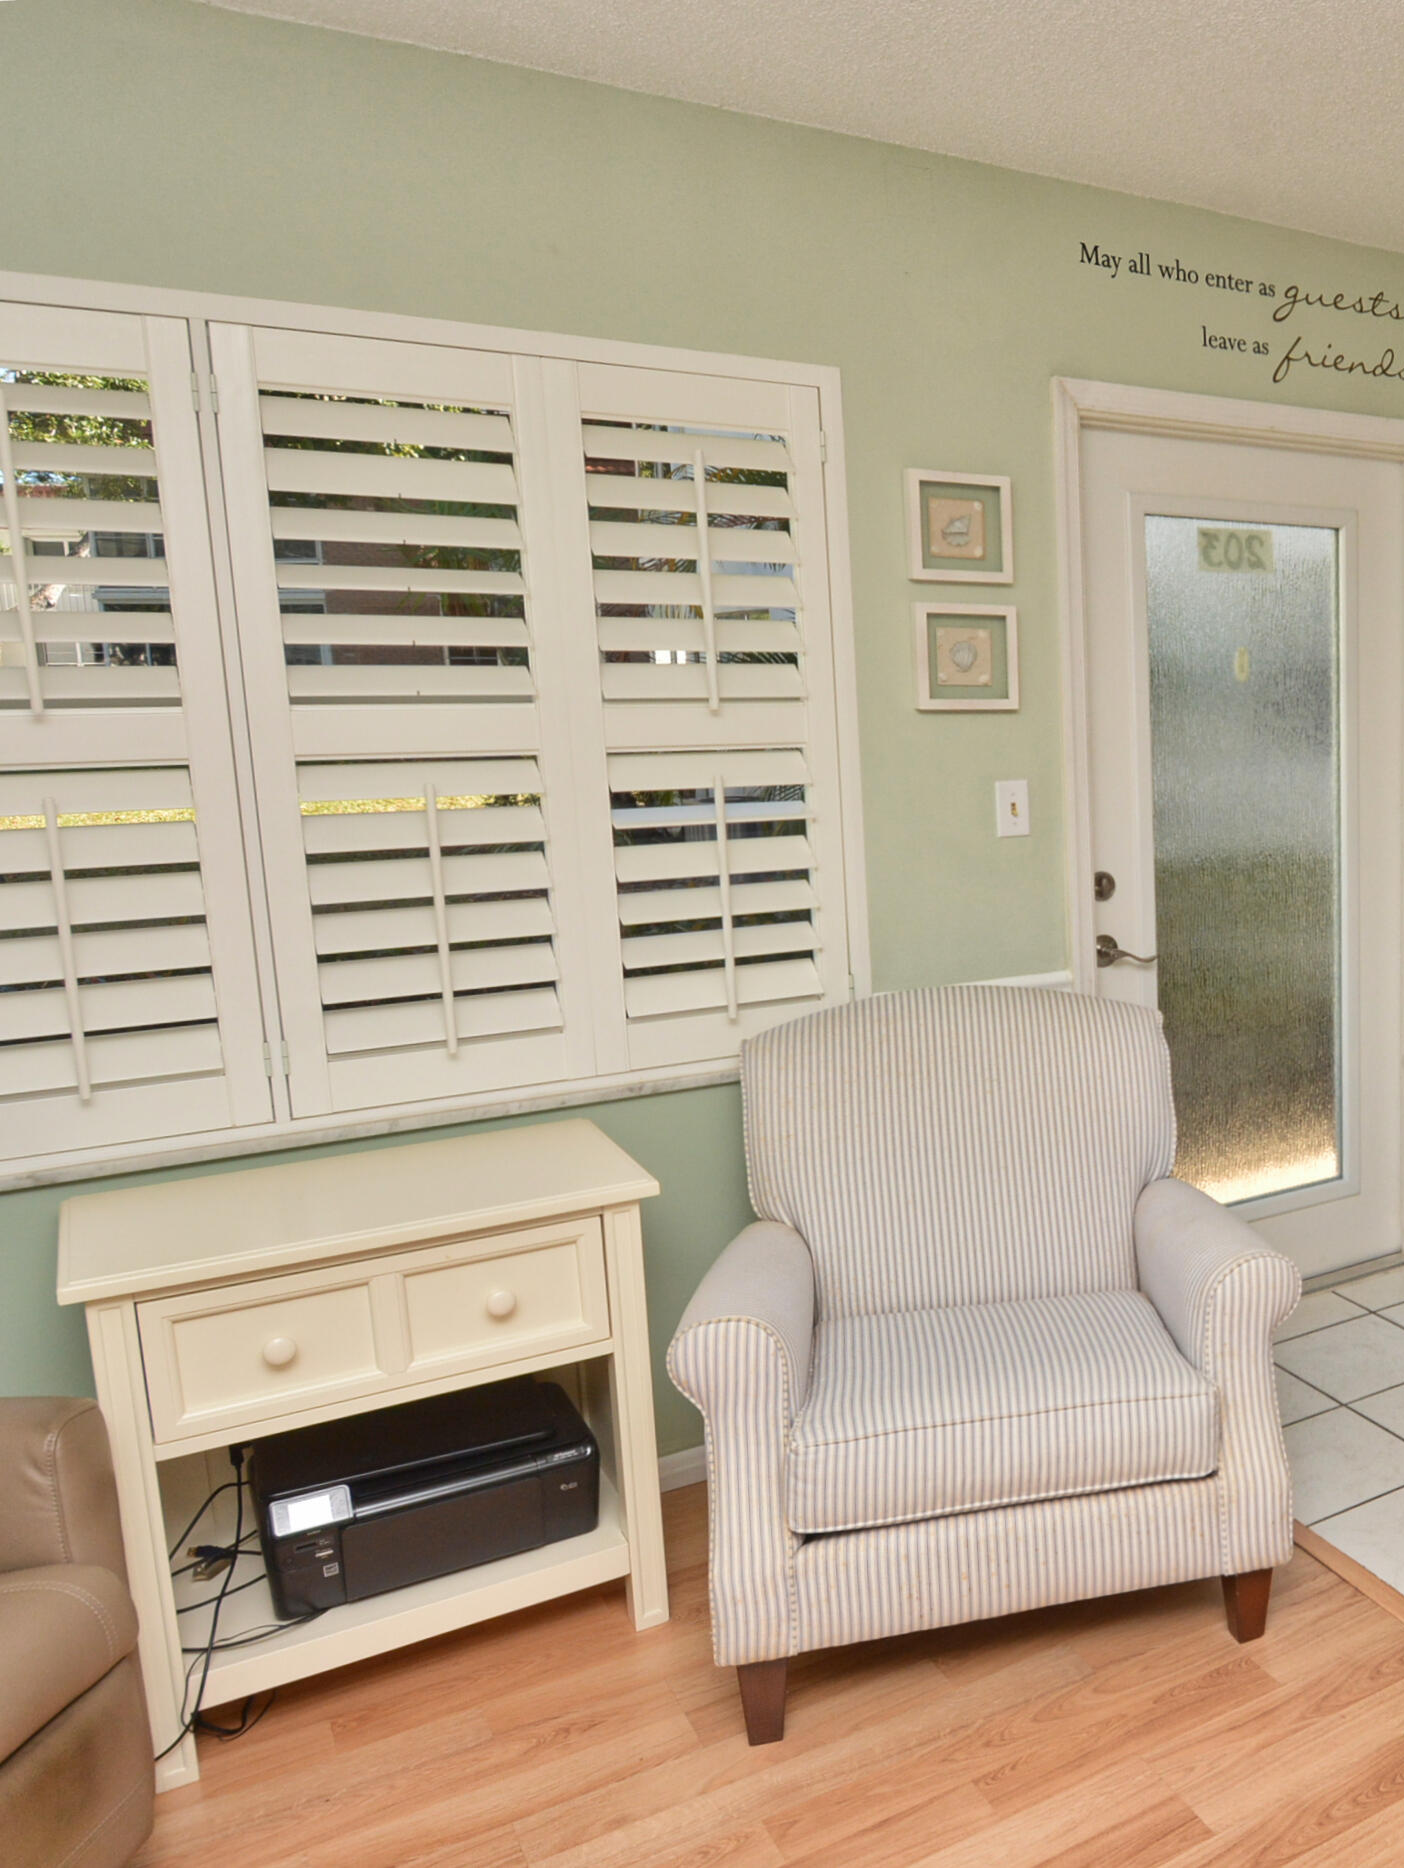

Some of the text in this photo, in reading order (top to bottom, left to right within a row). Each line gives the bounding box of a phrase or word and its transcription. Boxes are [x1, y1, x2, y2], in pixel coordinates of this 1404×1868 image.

[1080, 242, 1122, 278] May
[1128, 252, 1151, 276] all
[1158, 259, 1199, 284] who
[1205, 272, 1253, 293] enter
[1259, 282, 1276, 297] as
[1202, 326, 1246, 352] leave
[1252, 340, 1269, 354] as
